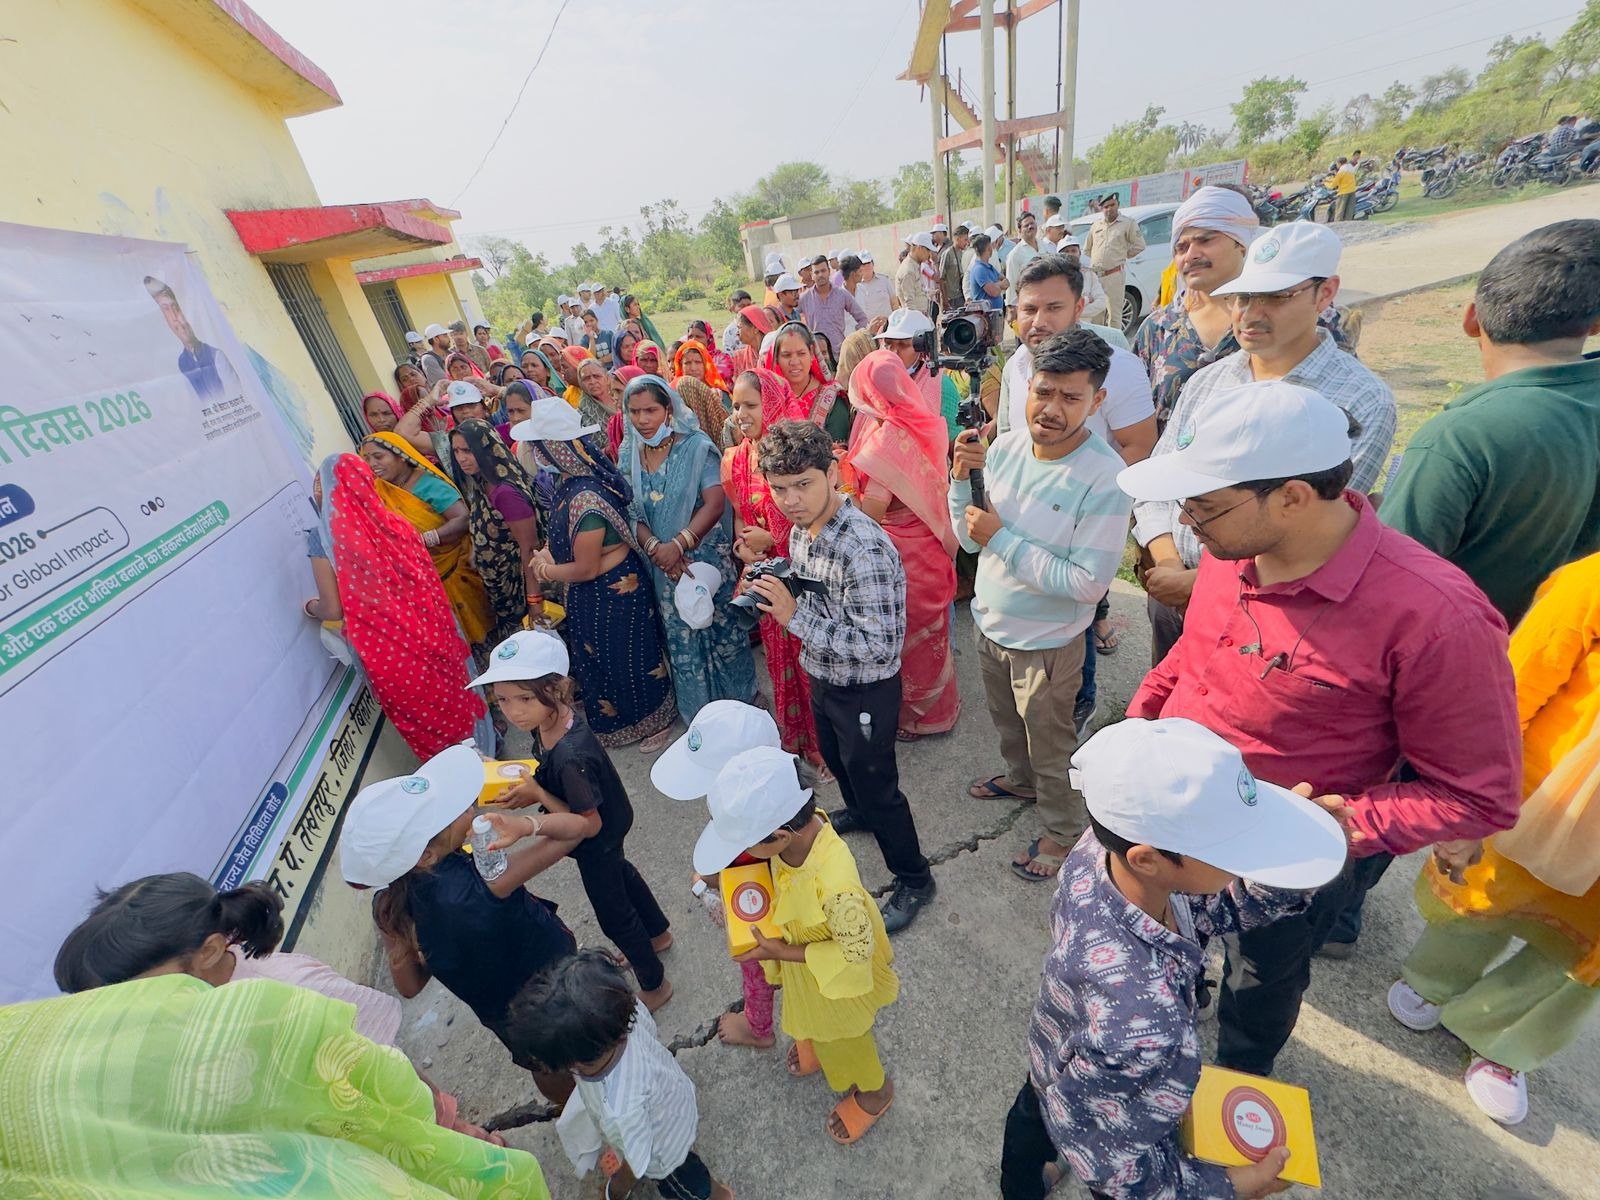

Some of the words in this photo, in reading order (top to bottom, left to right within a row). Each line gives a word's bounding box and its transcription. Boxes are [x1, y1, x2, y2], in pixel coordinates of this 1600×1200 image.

[0, 405, 94, 457] दिवस
[85, 391, 152, 433] 2026
[0, 531, 36, 565] 026
[0, 583, 13, 601] or
[12, 552, 67, 589] Global
[63, 528, 115, 562] Impact
[2, 631, 34, 658] और
[27, 615, 57, 641] एक
[52, 595, 90, 625] सतत
[84, 574, 122, 604] भविष्य
[116, 554, 149, 582] बनाने
[143, 548, 163, 565] का
[233, 846, 252, 866] जैव
[244, 811, 274, 850] विविधता
[266, 792, 282, 813] बोर्ड
